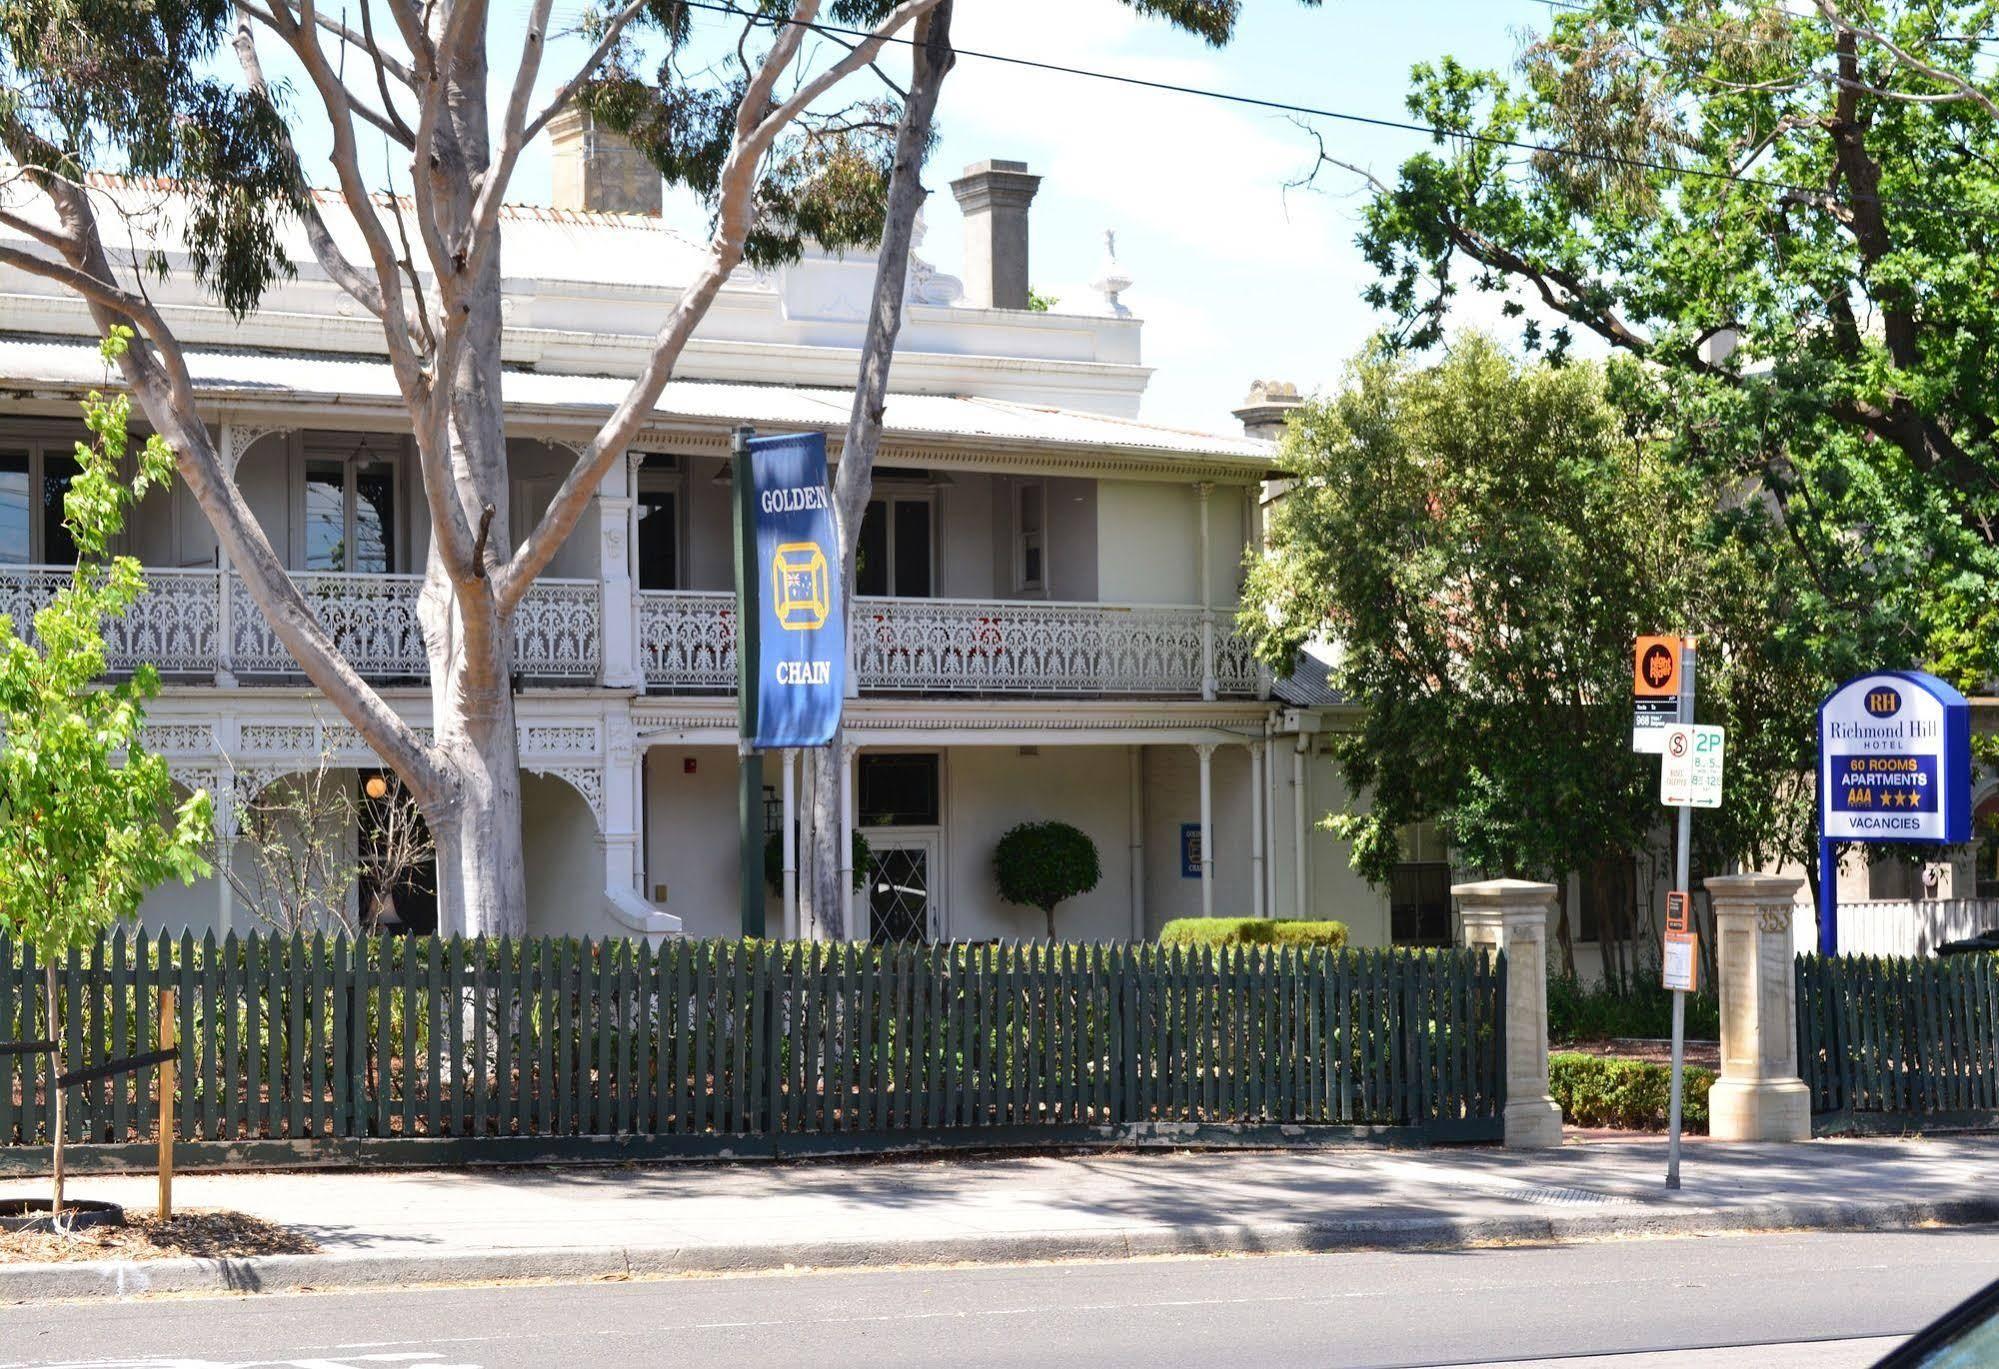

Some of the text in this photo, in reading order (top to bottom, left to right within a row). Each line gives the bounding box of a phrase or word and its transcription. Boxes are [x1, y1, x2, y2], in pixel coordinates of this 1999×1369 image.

[761, 485, 828, 513] GOLDEN
[776, 661, 831, 685] CHAIN
[1870, 693, 1896, 712] RH
[1831, 720, 1937, 740] Richmond Hill
[1696, 734, 1721, 752] 2P
[1864, 741, 1903, 750] HOTEL
[1850, 759, 1918, 771] 60 ROOMS
[1841, 773, 1927, 786] APARTMENTS
[1847, 788, 1872, 803] AAA
[1849, 817, 1920, 830] VACANCIES
